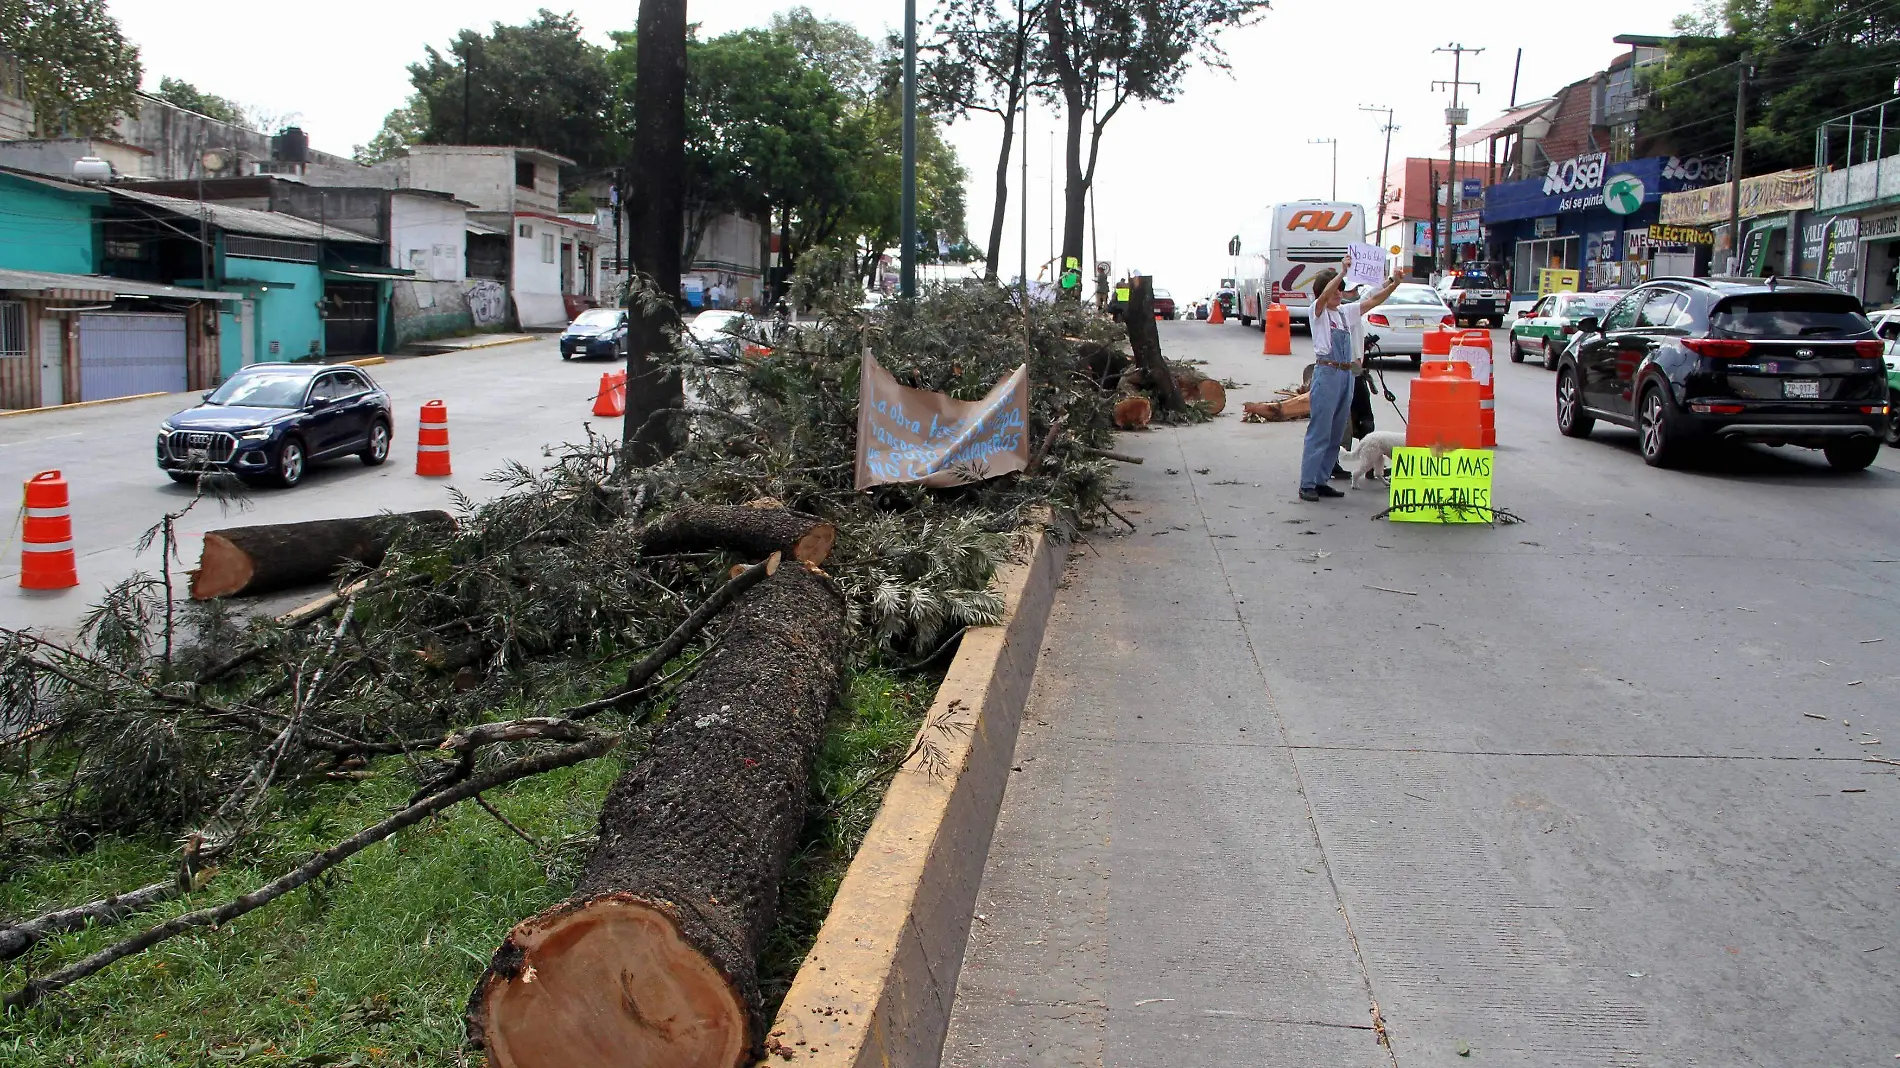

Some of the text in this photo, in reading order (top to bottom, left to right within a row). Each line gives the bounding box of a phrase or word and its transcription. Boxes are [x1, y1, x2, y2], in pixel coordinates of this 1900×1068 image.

[1561, 152, 1607, 193] Osel
[1571, 199, 1582, 209] se
[1582, 193, 1603, 210] pinta
[1287, 210, 1353, 232] AU
[1395, 453, 1490, 477] NI UNO MAS
[1393, 488, 1416, 513] NO
